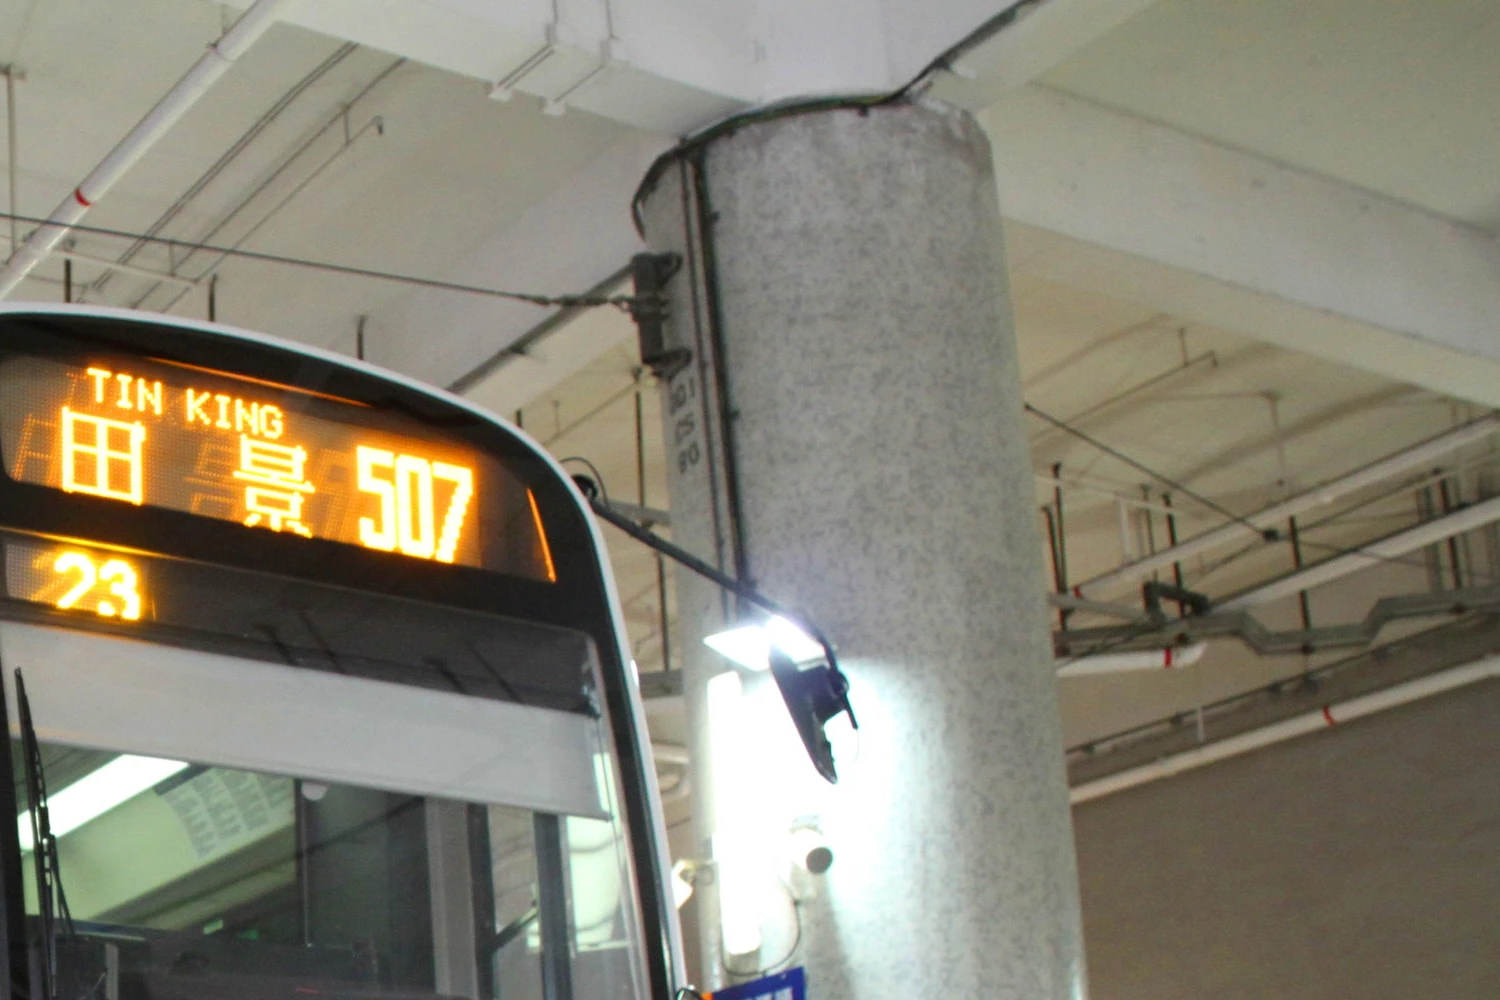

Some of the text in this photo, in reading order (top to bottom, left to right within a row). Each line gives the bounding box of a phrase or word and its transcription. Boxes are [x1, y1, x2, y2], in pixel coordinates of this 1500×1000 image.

[87, 367, 283, 439] TIN KING
[356, 445, 474, 562] 507
[52, 552, 140, 620] 23
